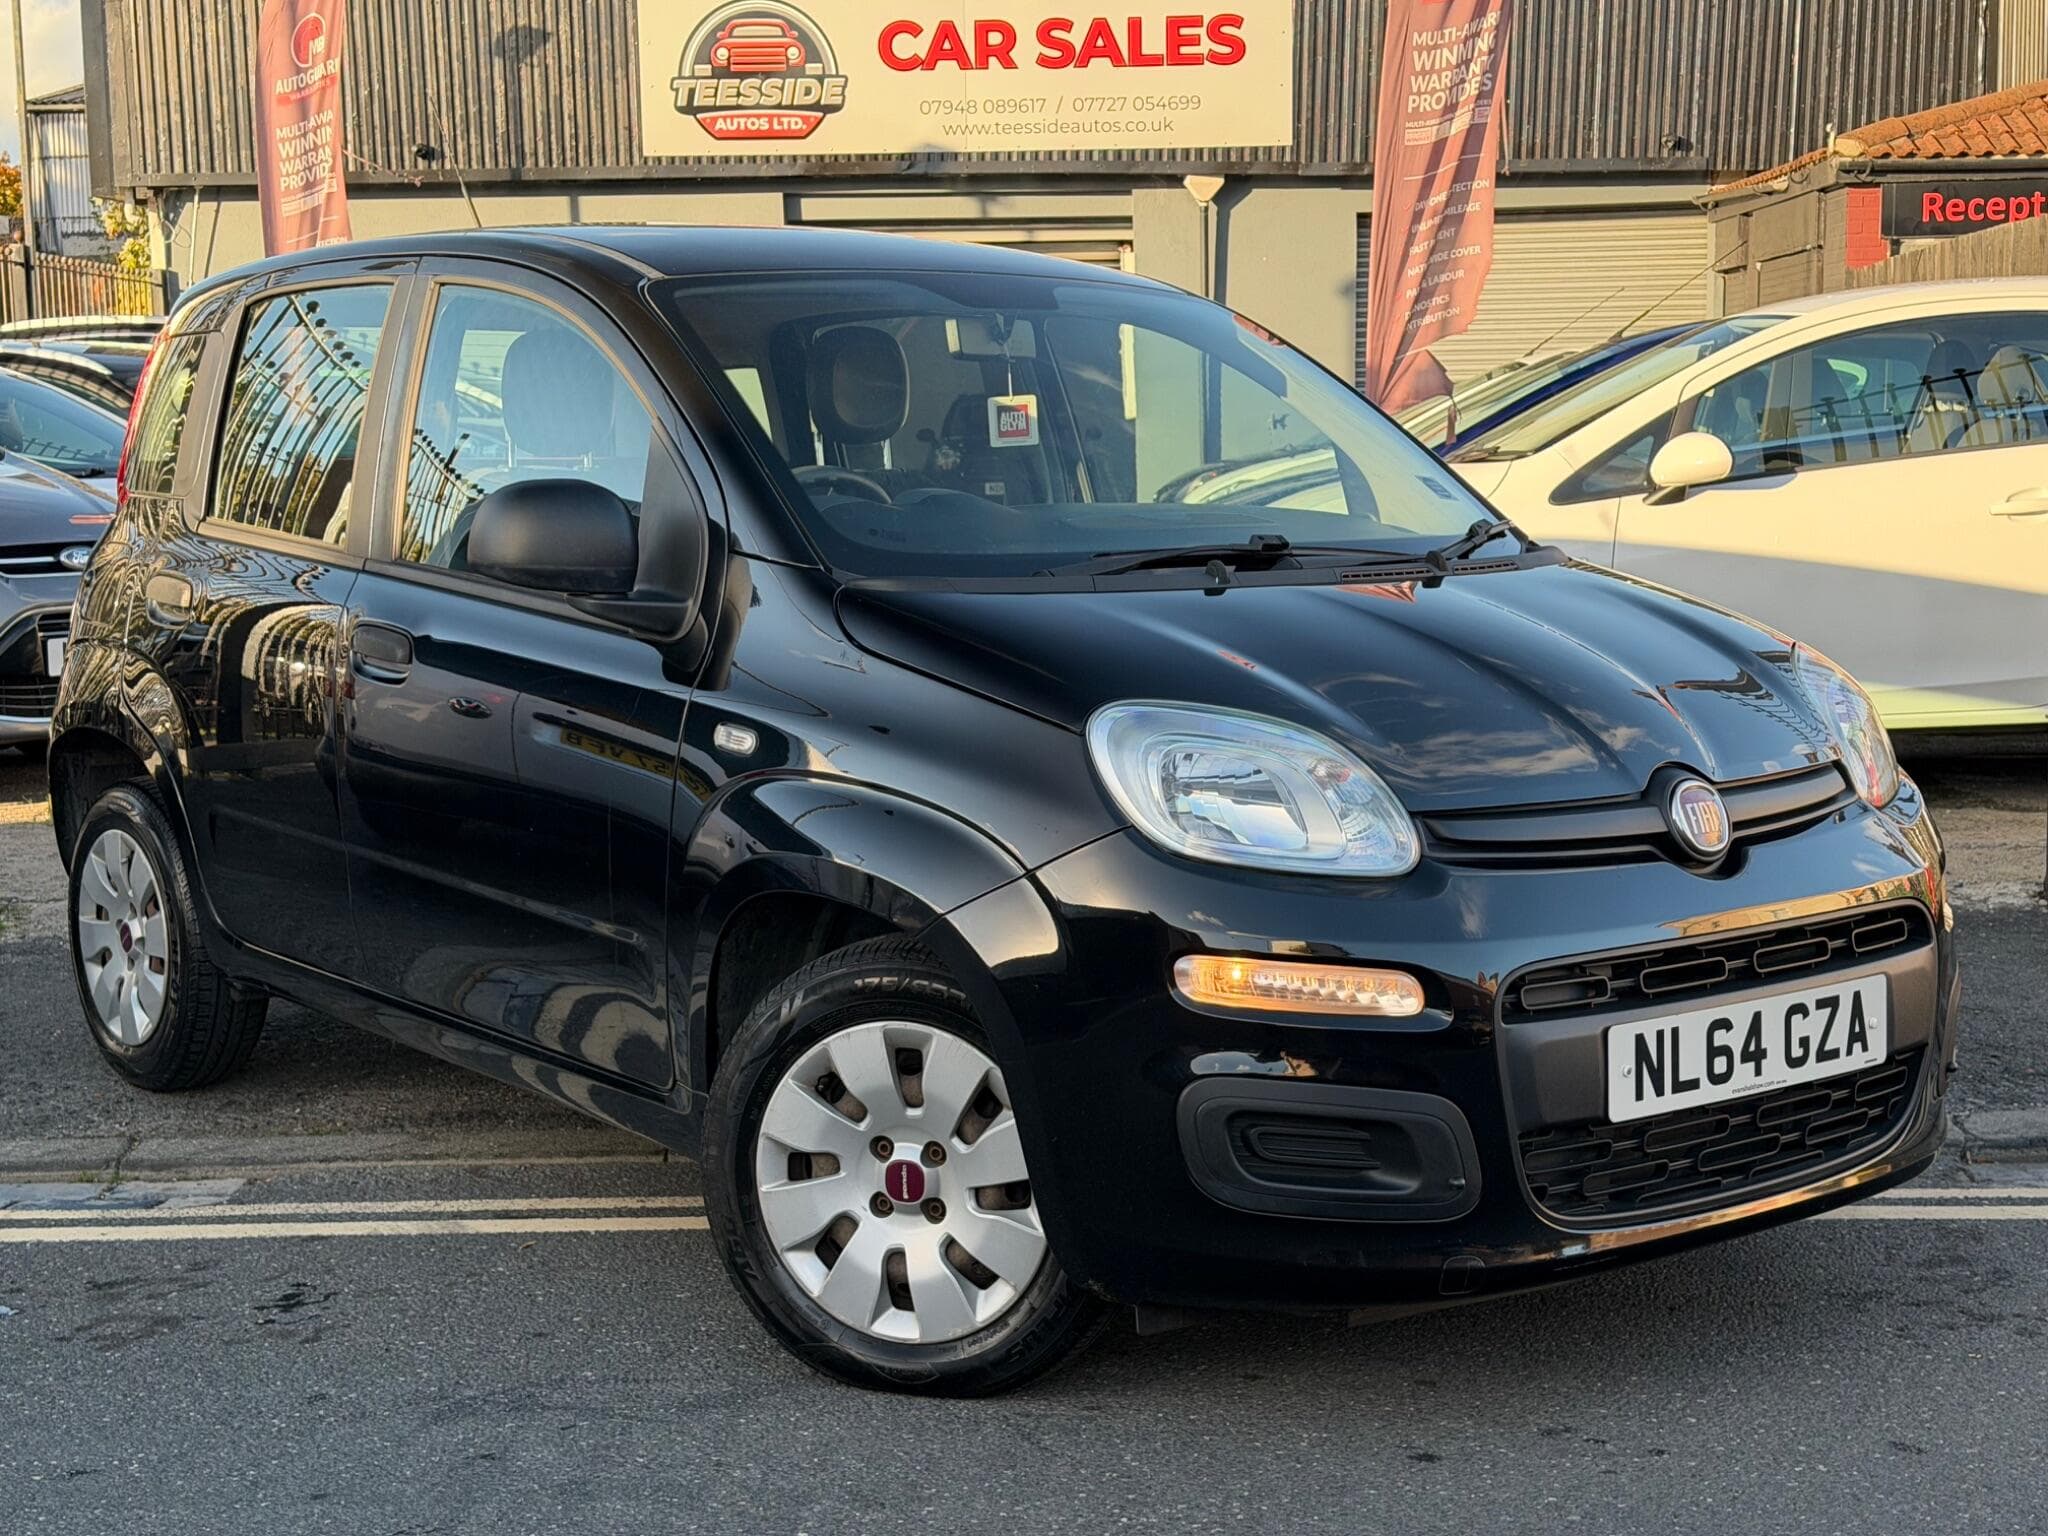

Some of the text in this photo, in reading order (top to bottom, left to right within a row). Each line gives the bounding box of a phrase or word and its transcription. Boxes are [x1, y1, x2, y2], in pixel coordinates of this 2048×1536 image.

[877, 13, 1246, 72] CAR SALES
[672, 77, 847, 107] TEESSIDE
[919, 100, 978, 115] 07948
[983, 98, 1046, 114] 089617
[1072, 96, 1128, 112] 07727
[1132, 95, 1202, 111] 054699
[715, 117, 807, 131] AUTOS LTD.
[942, 117, 1175, 136] www.teessideautos.co.uk
[1450, 245, 1481, 258] COVER
[1428, 269, 1465, 286] LABOUR
[1000, 411, 1025, 421] AUTO
[1684, 800, 1720, 834] FIAT
[1634, 989, 1869, 1102] NL64 GZA
